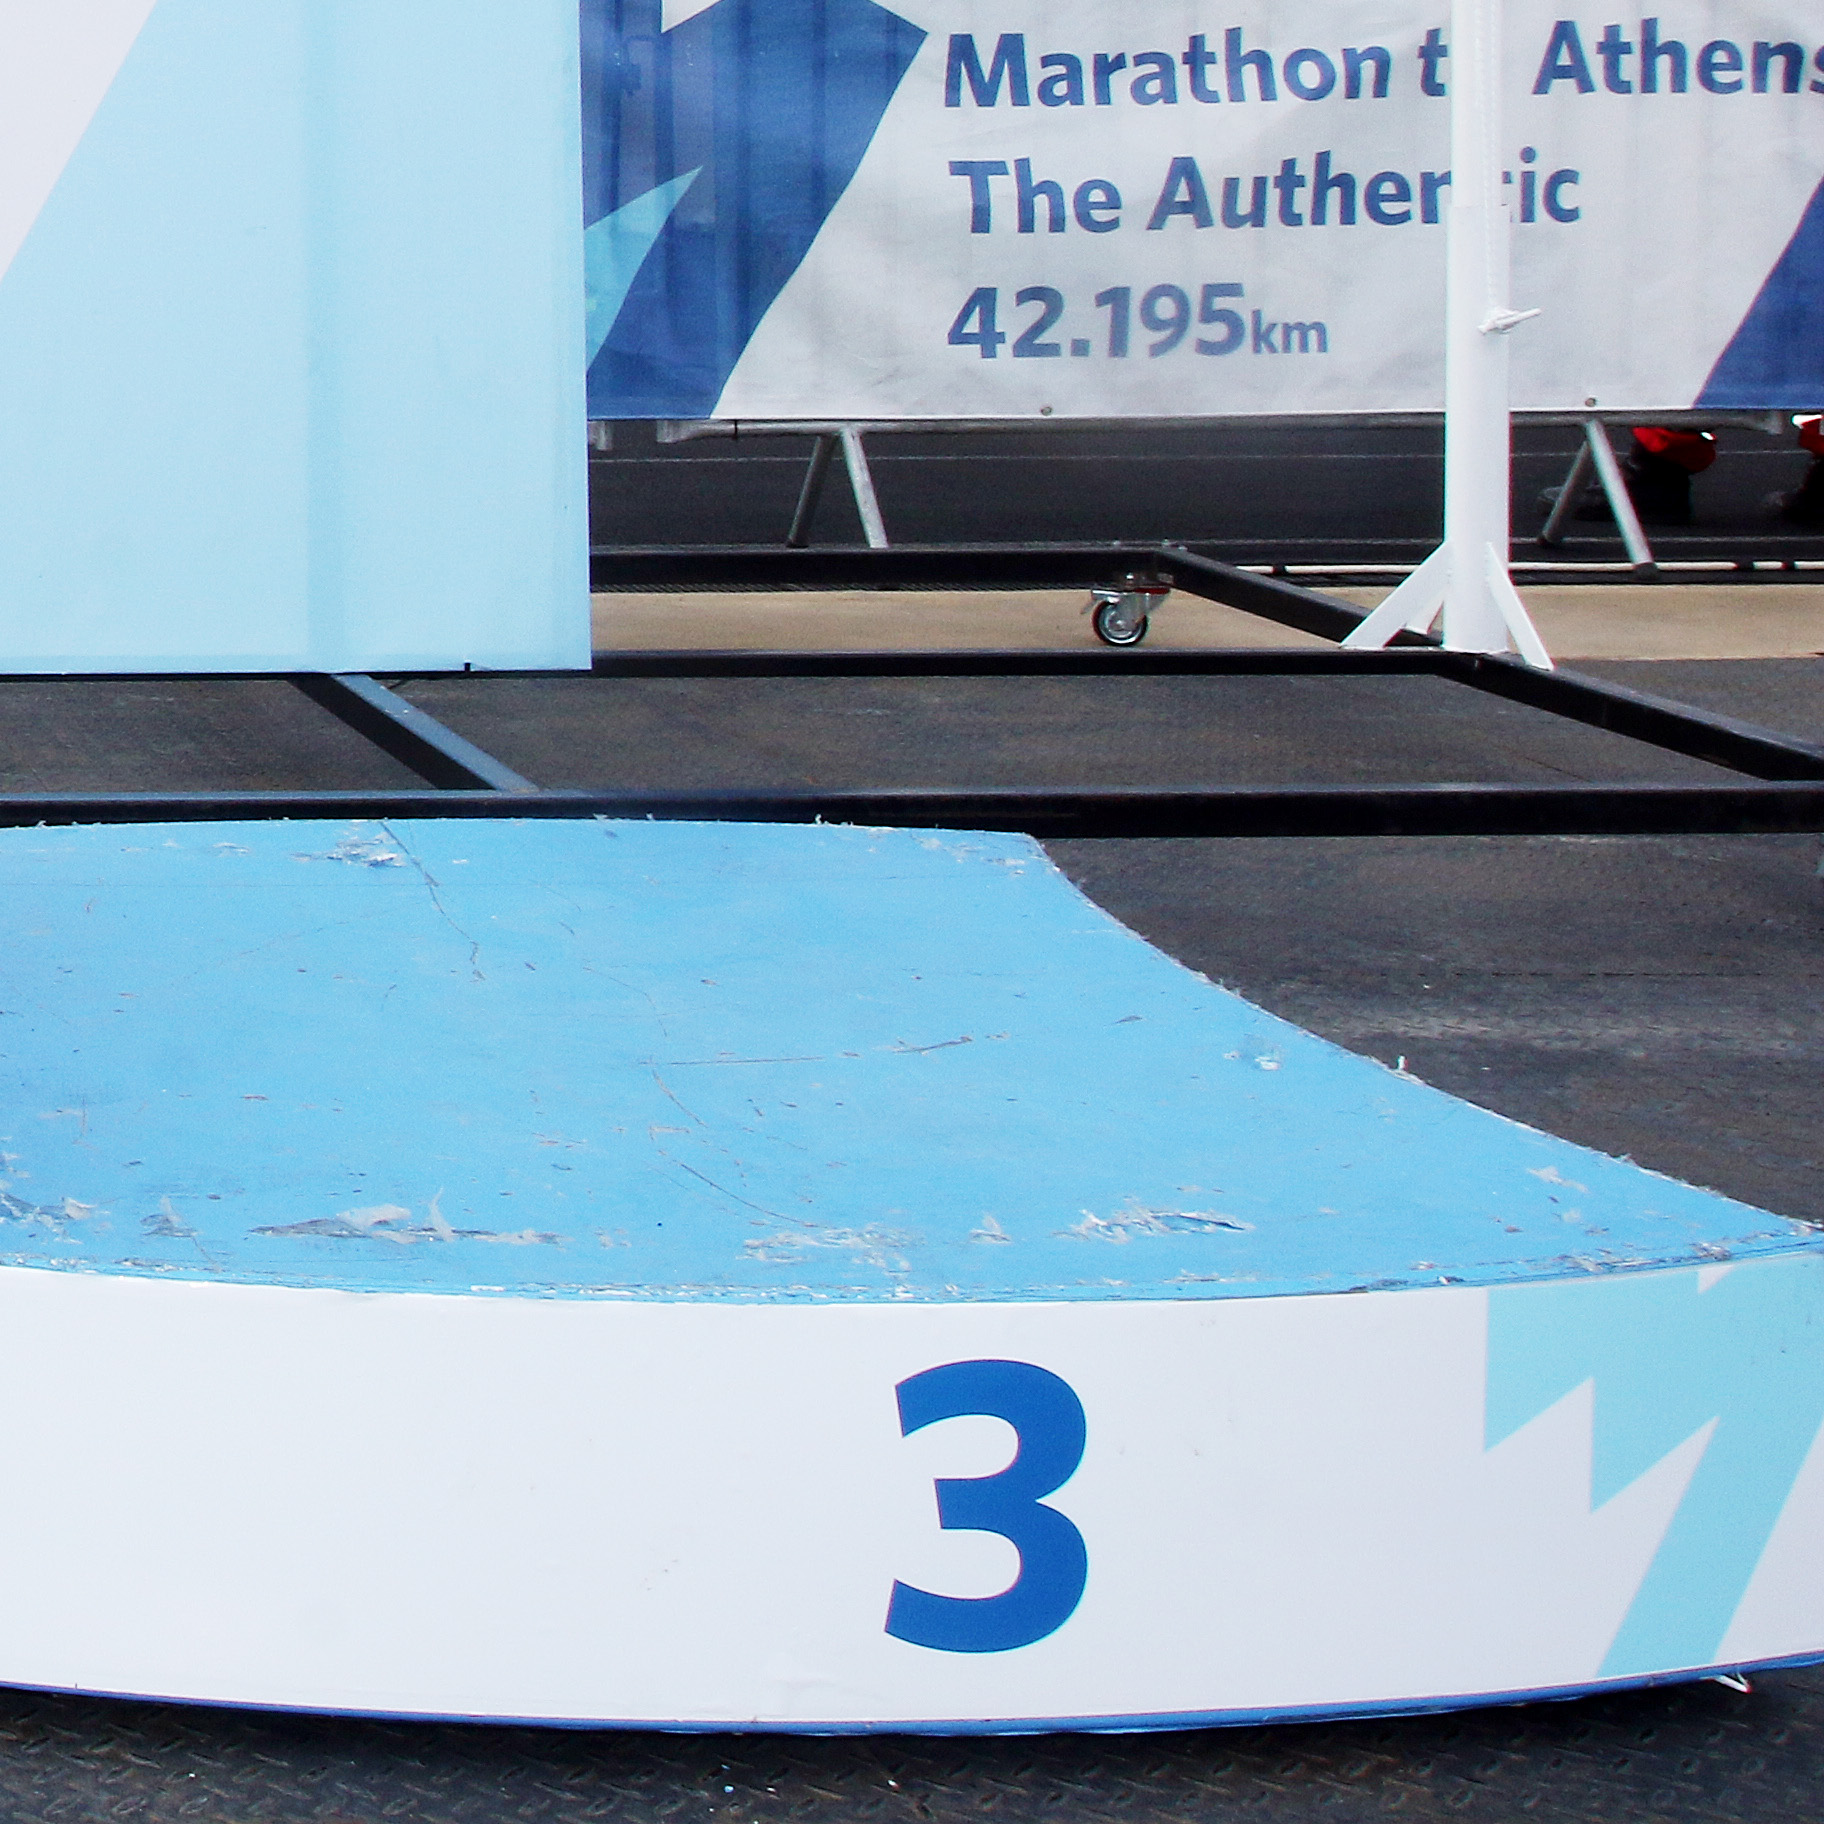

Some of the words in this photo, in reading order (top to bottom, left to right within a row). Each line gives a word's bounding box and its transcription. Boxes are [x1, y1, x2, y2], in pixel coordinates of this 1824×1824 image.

[944, 26, 1393, 108] Marathon
[949, 156, 1123, 235] The
[1147, 146, 1582, 232] Authenic
[886, 1360, 1089, 1655] 3
